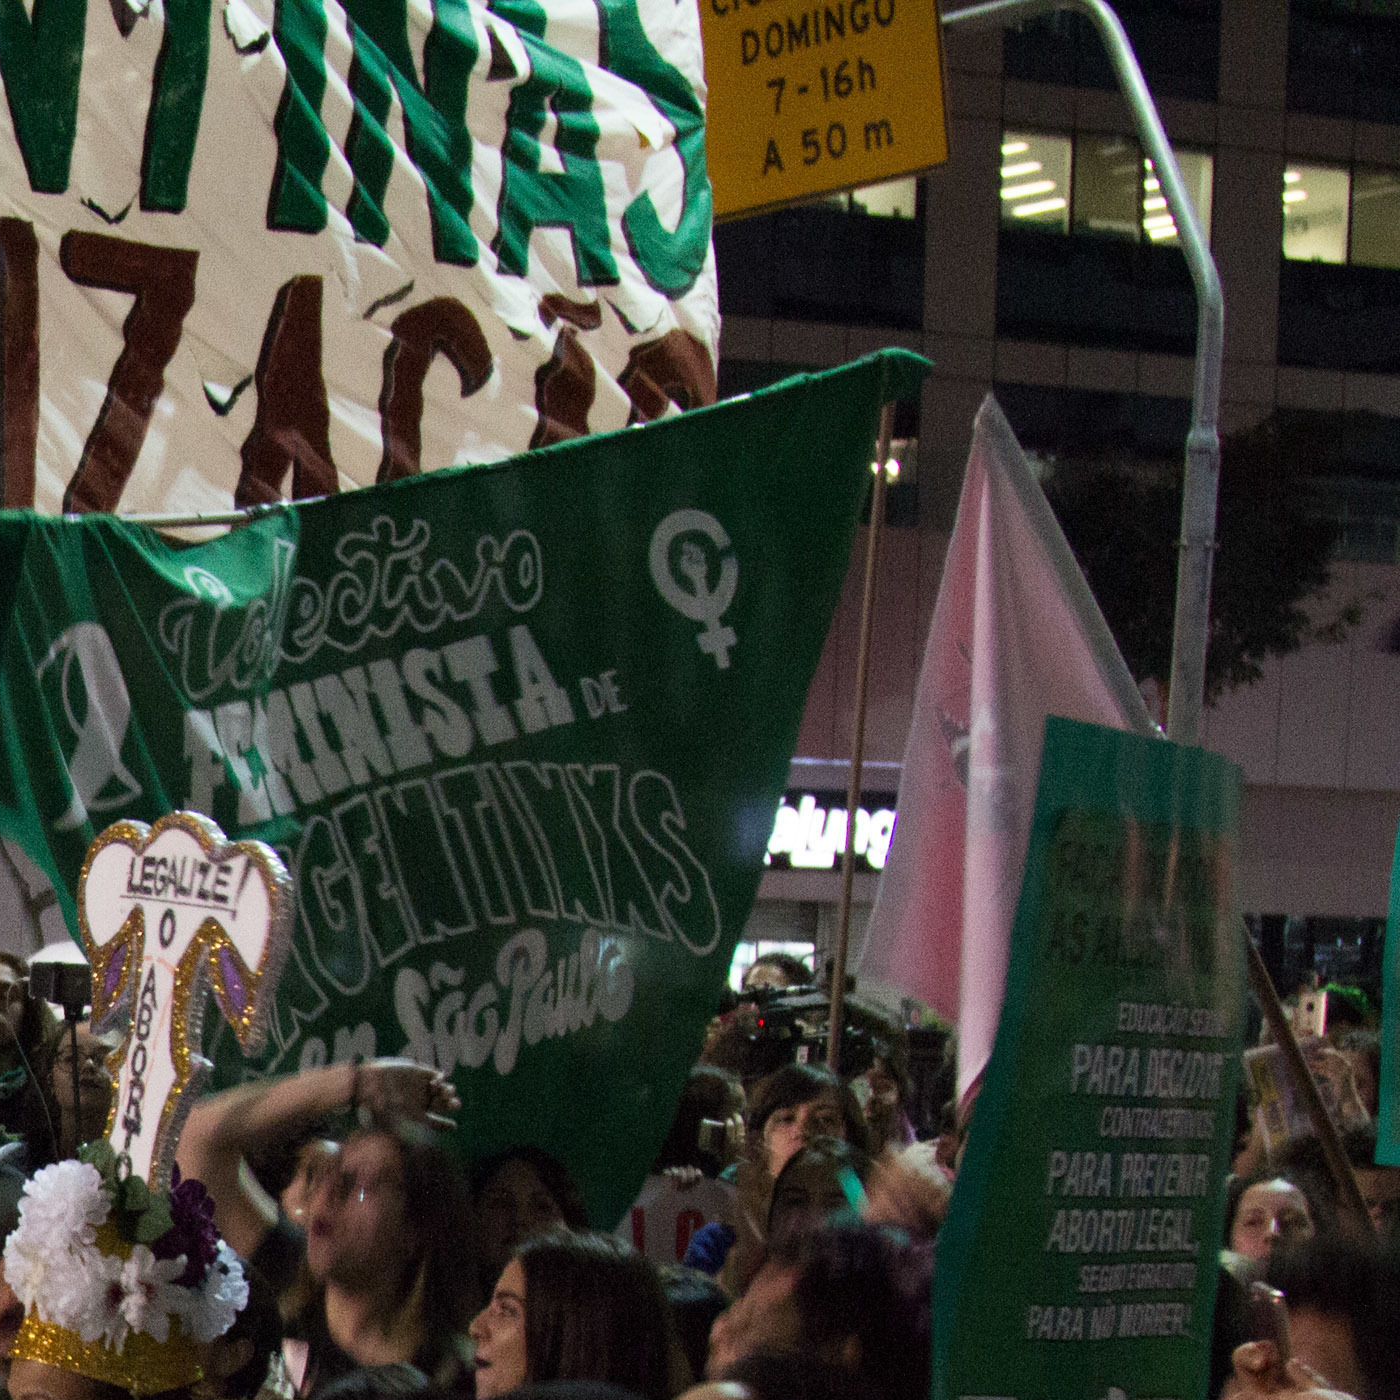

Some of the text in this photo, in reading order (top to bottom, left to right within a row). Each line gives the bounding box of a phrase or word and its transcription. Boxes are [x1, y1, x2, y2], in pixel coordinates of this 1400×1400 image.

[741, 0, 895, 66] DOMINGO
[763, 118, 894, 176] A 50 m
[183, 624, 628, 826] FEMINISTA DE
[158, 908, 176, 949] O
[255, 762, 721, 1050] GENTINXS
[395, 961, 502, 1073] São
[495, 928, 635, 1076] Paulo
[1071, 1044, 1140, 1096] PARA
[1046, 1150, 1210, 1197] PARA PREVENIR
[1046, 1209, 1135, 1253] ABORTO
[1025, 1305, 1084, 1340] PARA
